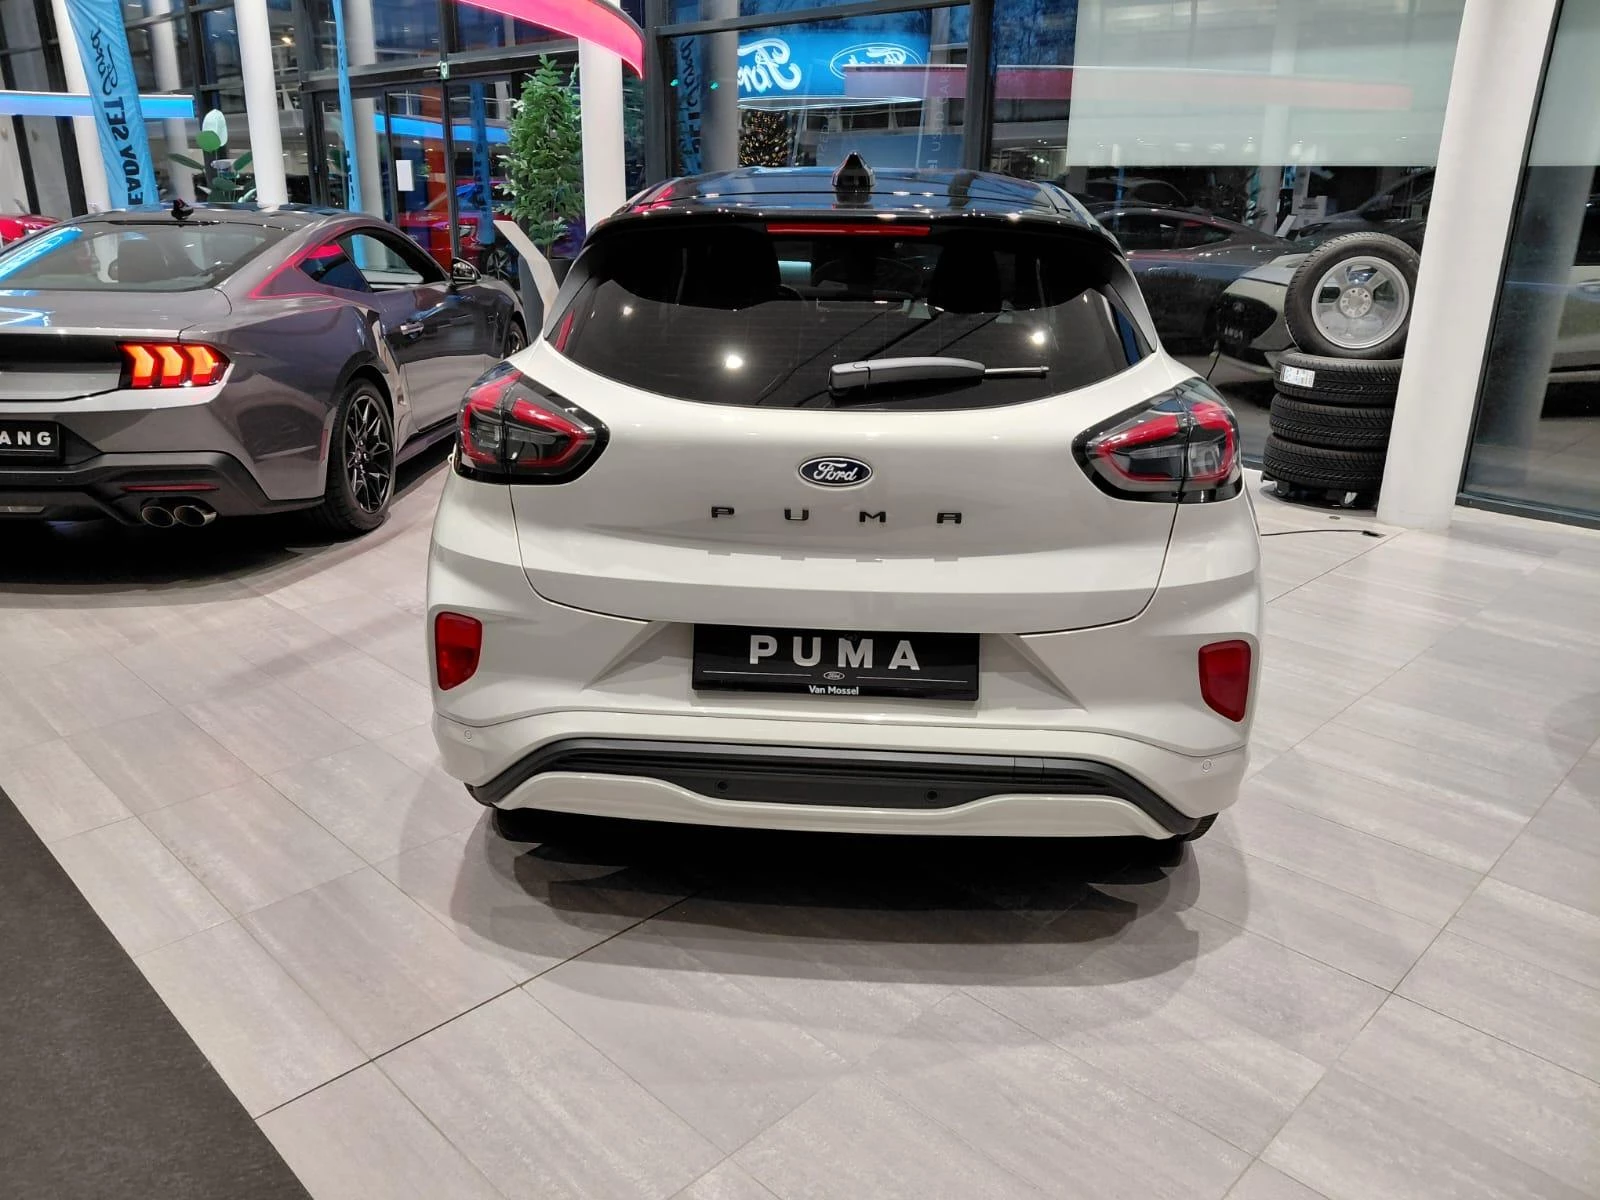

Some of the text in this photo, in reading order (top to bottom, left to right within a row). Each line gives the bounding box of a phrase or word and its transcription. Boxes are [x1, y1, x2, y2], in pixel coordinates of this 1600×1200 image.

[0, 430, 52, 446] ANG
[813, 461, 858, 482] Ford
[711, 506, 962, 524] PUMA
[750, 634, 920, 671] PUMA
[808, 684, 859, 695] Van Mossel
